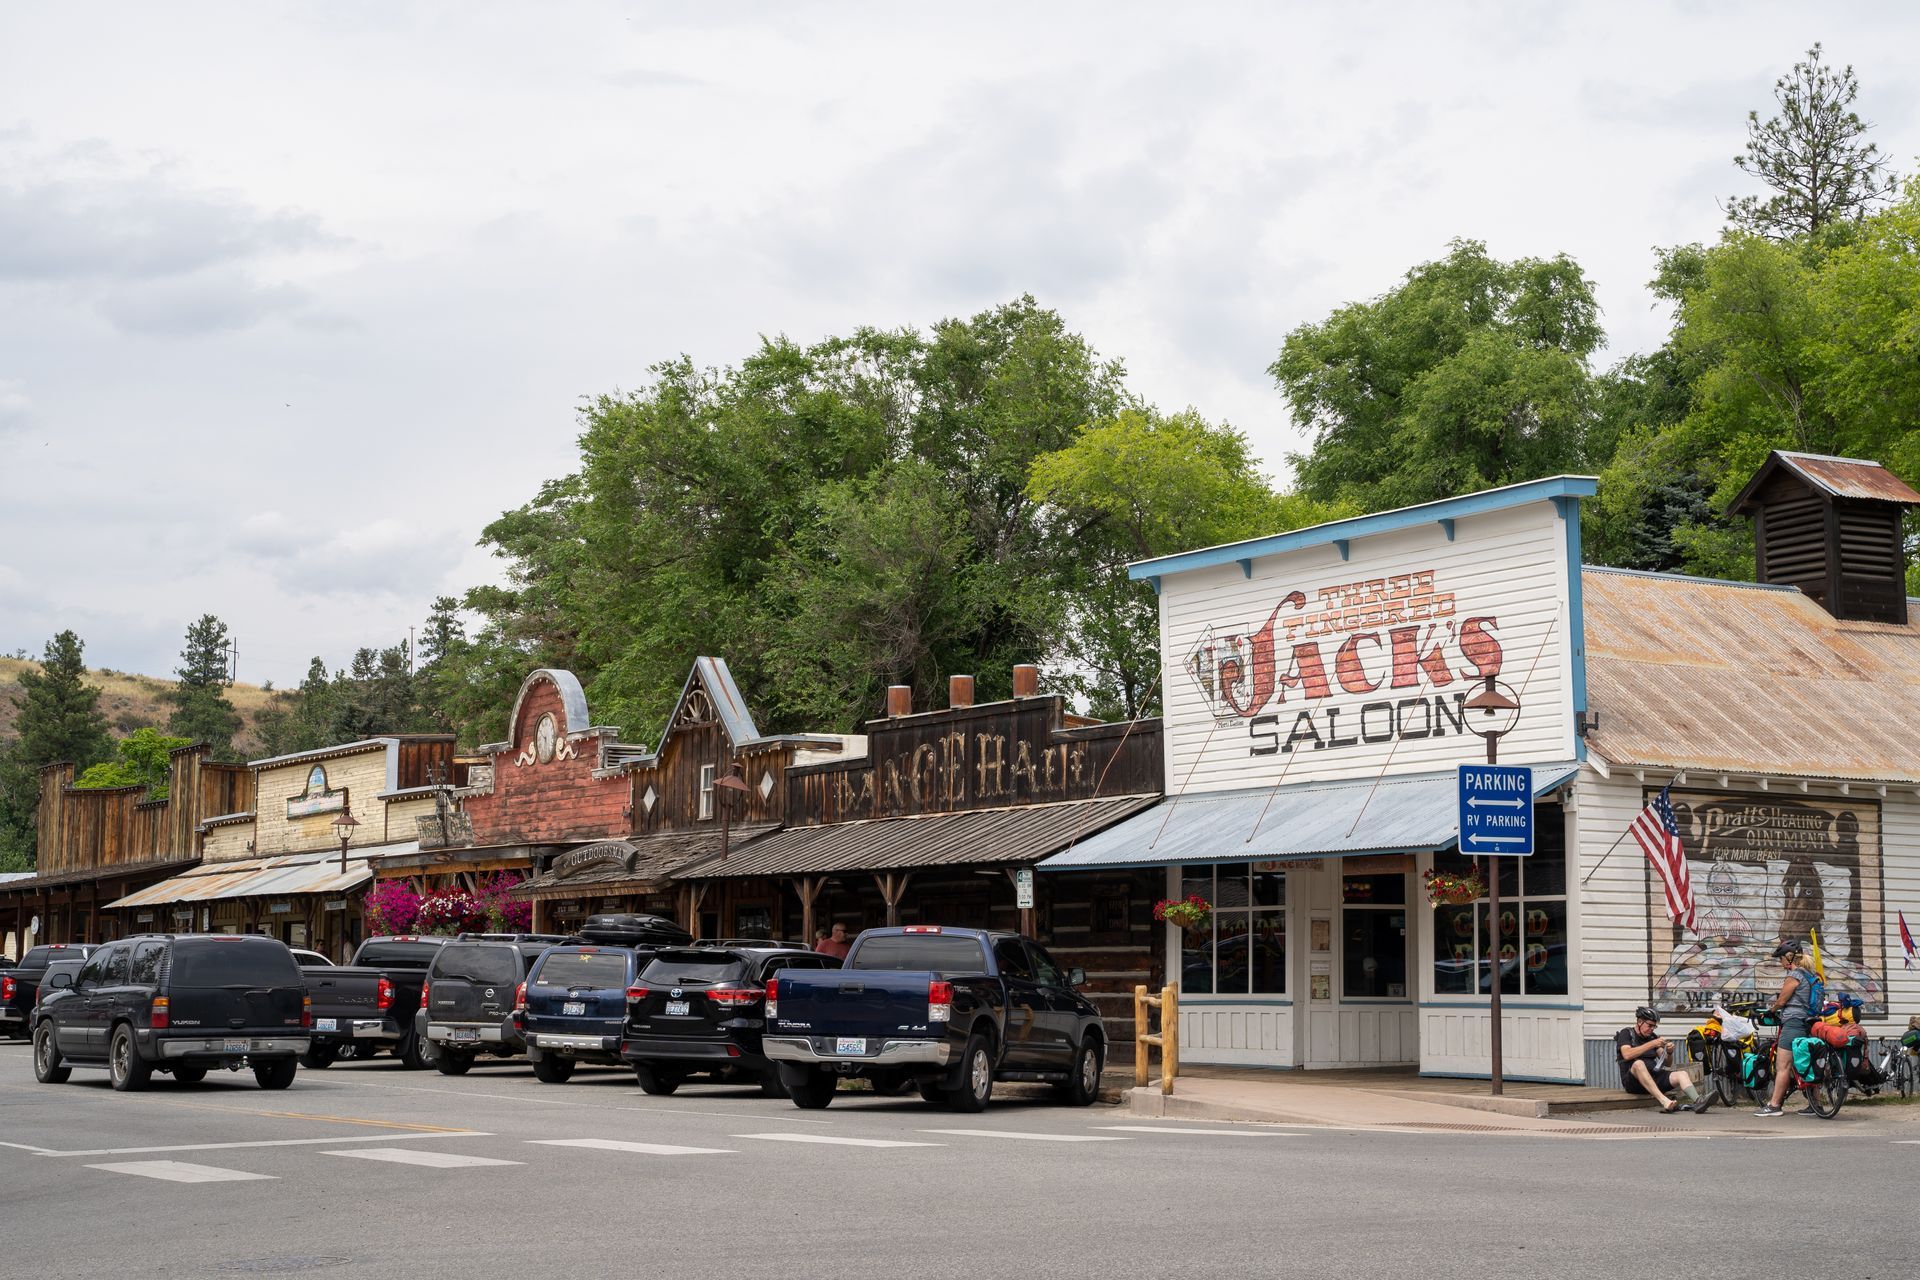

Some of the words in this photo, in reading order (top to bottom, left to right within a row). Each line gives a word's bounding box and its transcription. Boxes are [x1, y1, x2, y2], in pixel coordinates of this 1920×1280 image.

[1319, 569, 1435, 610] THREE
[1283, 592, 1457, 642] FINGERED
[1221, 590, 1503, 717] JACK'S
[1249, 692, 1465, 757] SALOON
[1465, 773, 1526, 792] PARKING
[1467, 814, 1480, 826] RV
[1486, 815, 1527, 828] PARKING
[1746, 829, 1827, 849] OINTMENT
[1712, 847, 1729, 861] FOR
[1731, 847, 1750, 861] MAN
[1756, 848, 1783, 862] BEAST
[1685, 991, 1714, 1009] WE
